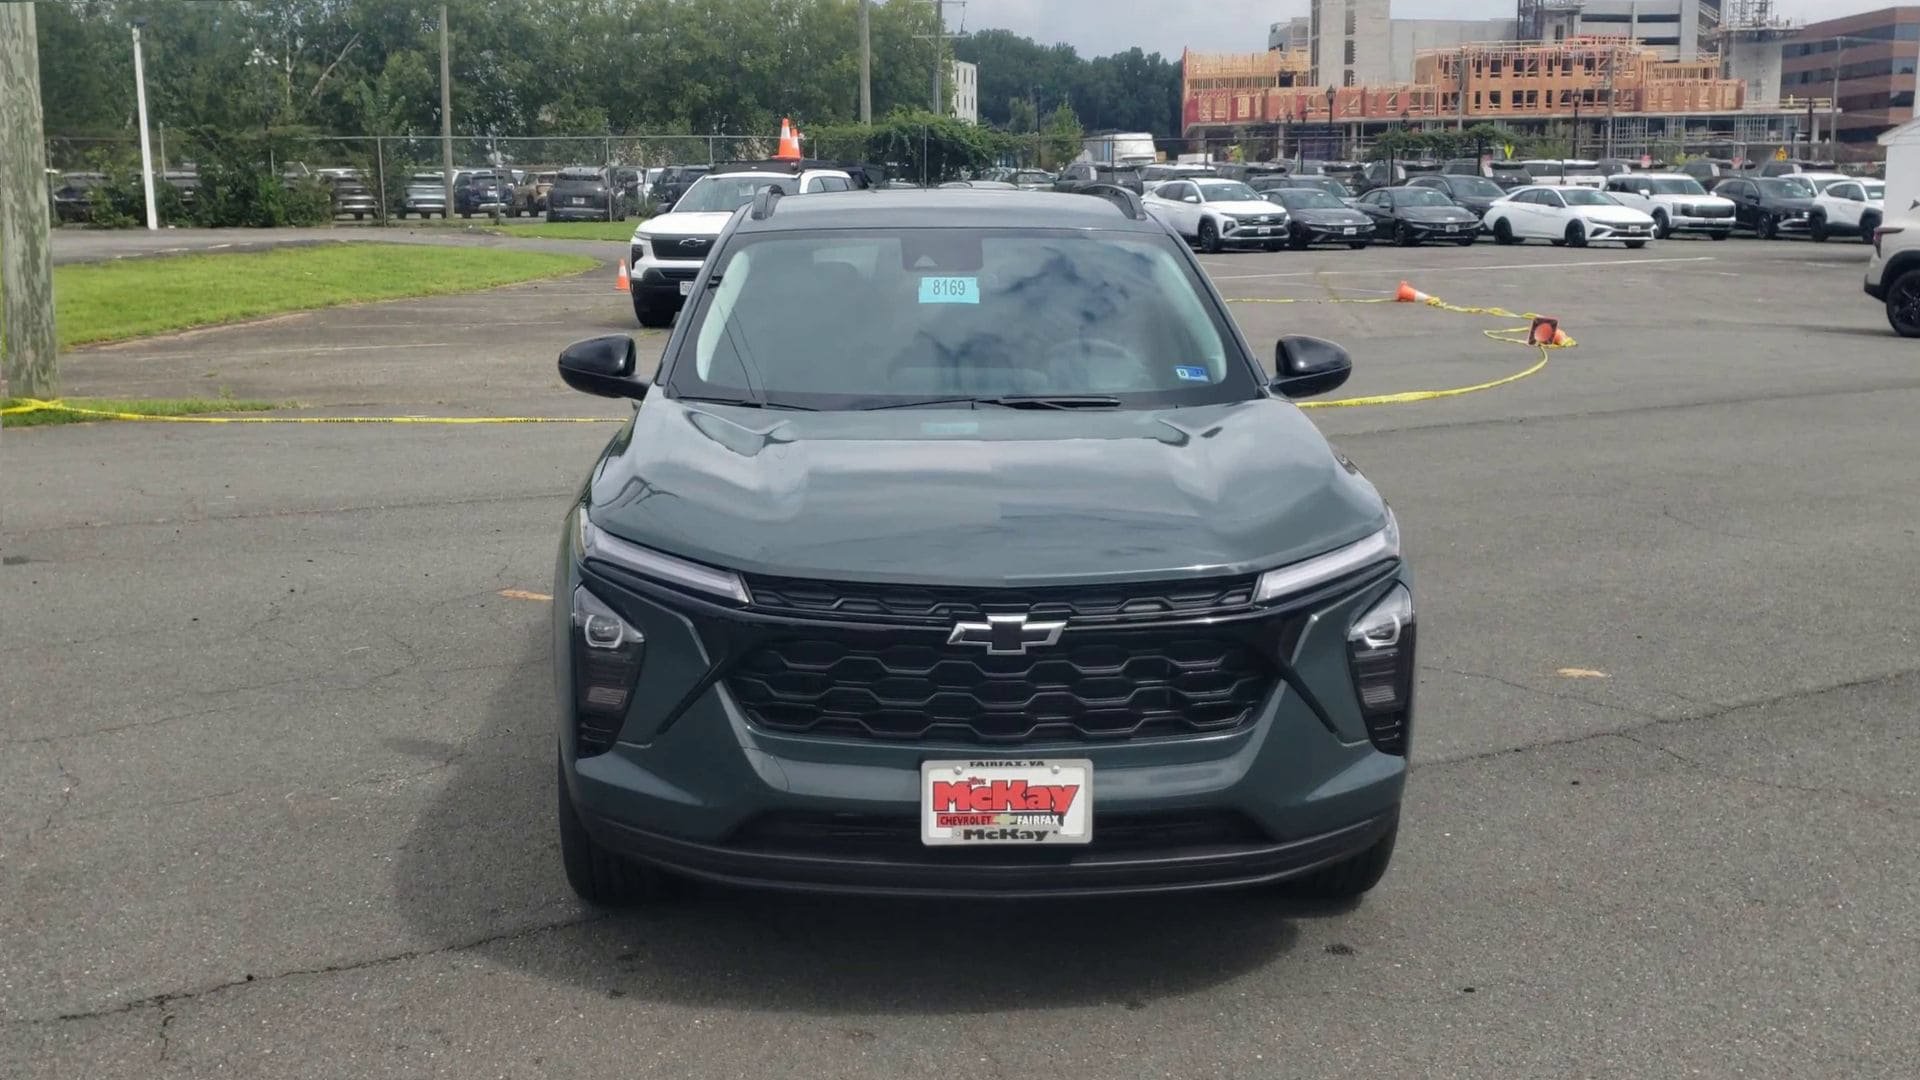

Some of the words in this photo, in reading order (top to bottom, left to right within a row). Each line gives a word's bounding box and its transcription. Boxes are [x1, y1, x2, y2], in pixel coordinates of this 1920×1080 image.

[933, 279, 965, 296] 8169
[932, 780, 1080, 815] McKay
[940, 815, 992, 825] CHEVROLET
[1017, 815, 1059, 825] FAIRFAX
[963, 828, 1049, 841] McKay
